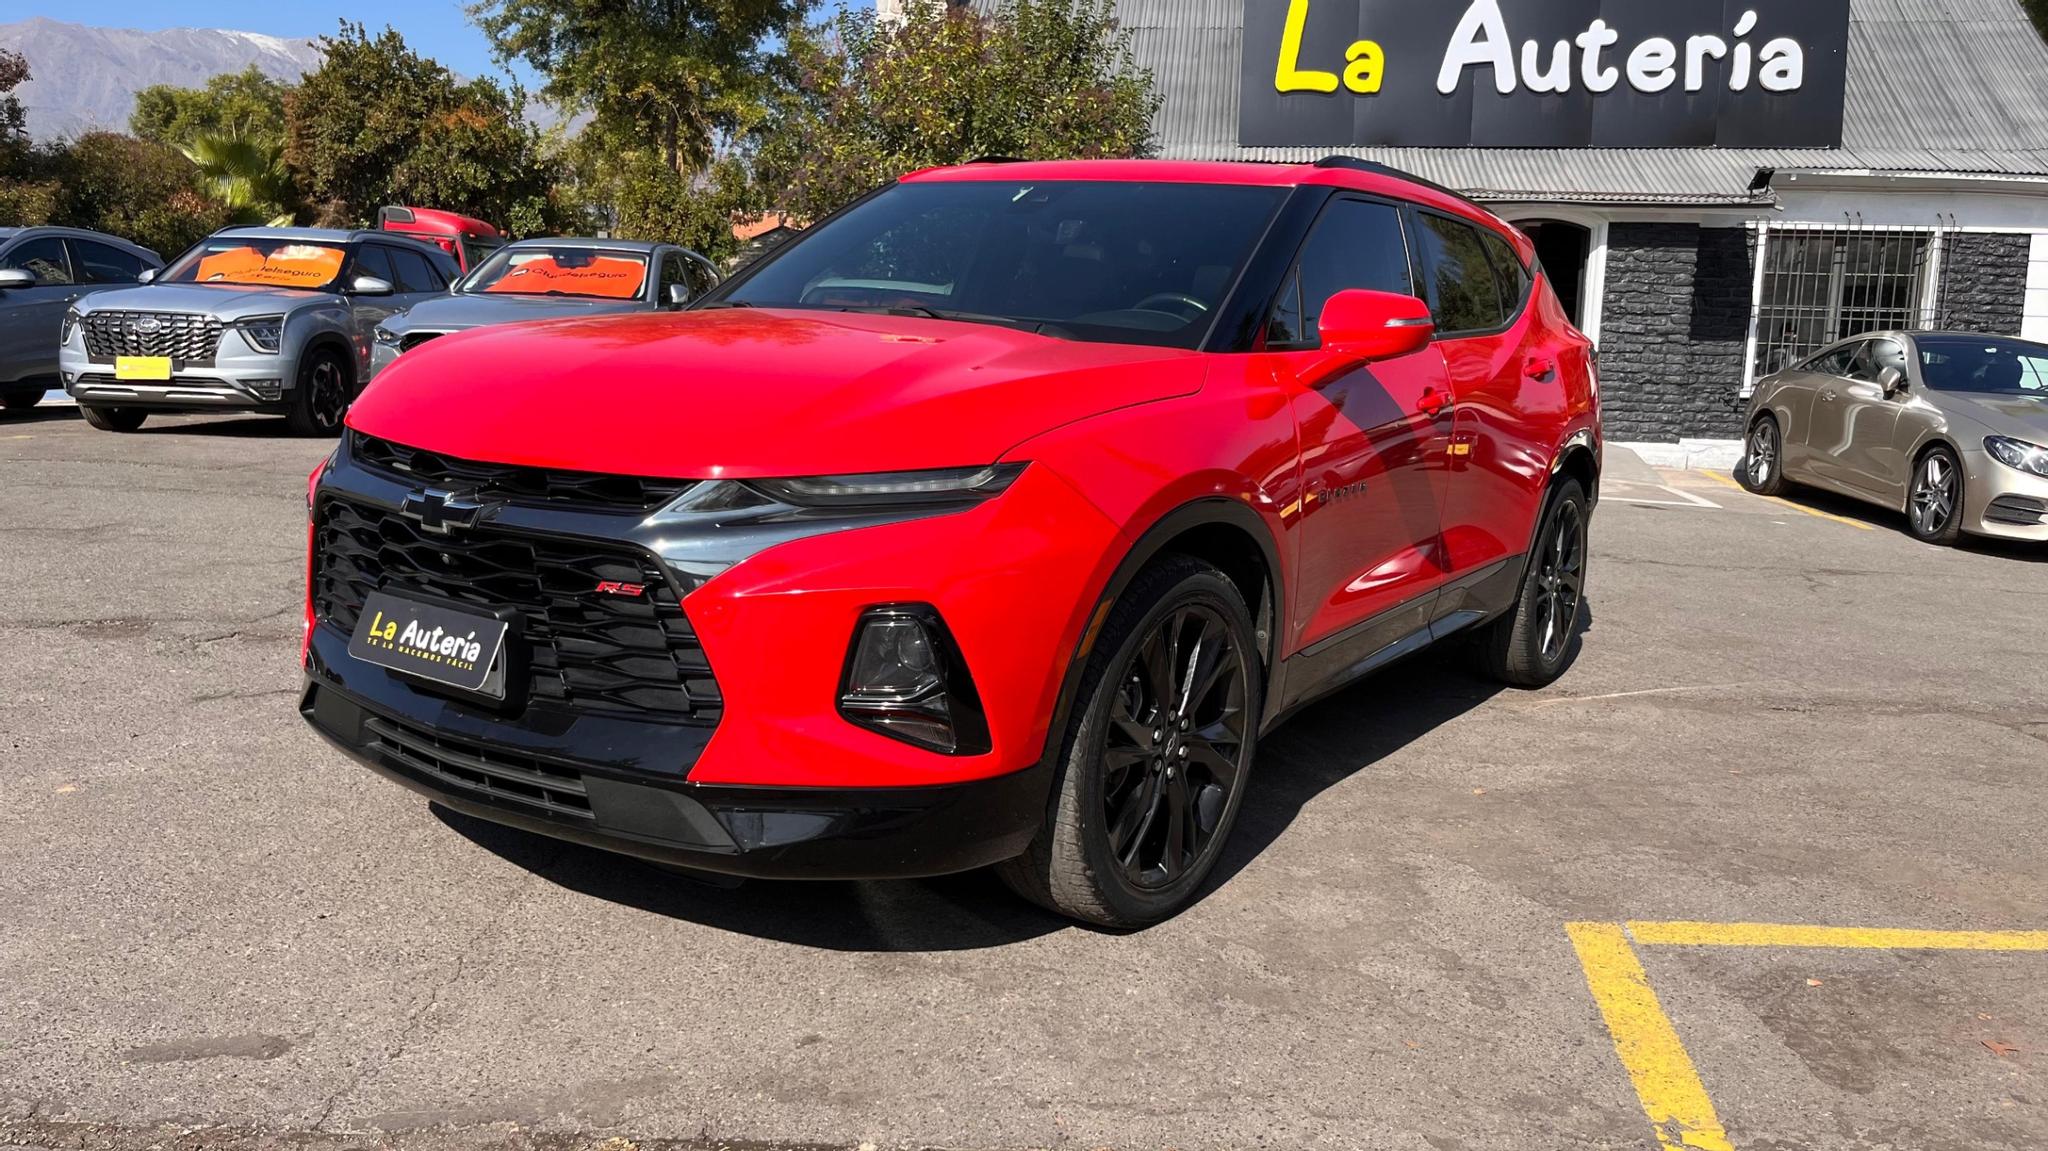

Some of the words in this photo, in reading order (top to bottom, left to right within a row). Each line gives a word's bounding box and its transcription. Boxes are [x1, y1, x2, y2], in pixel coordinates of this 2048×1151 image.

[1275, 0, 1385, 93] La
[1437, 0, 1804, 94] Autería
[595, 580, 645, 596] RS
[367, 637, 378, 646] TE
[369, 611, 398, 641] La
[399, 619, 481, 662] Autería
